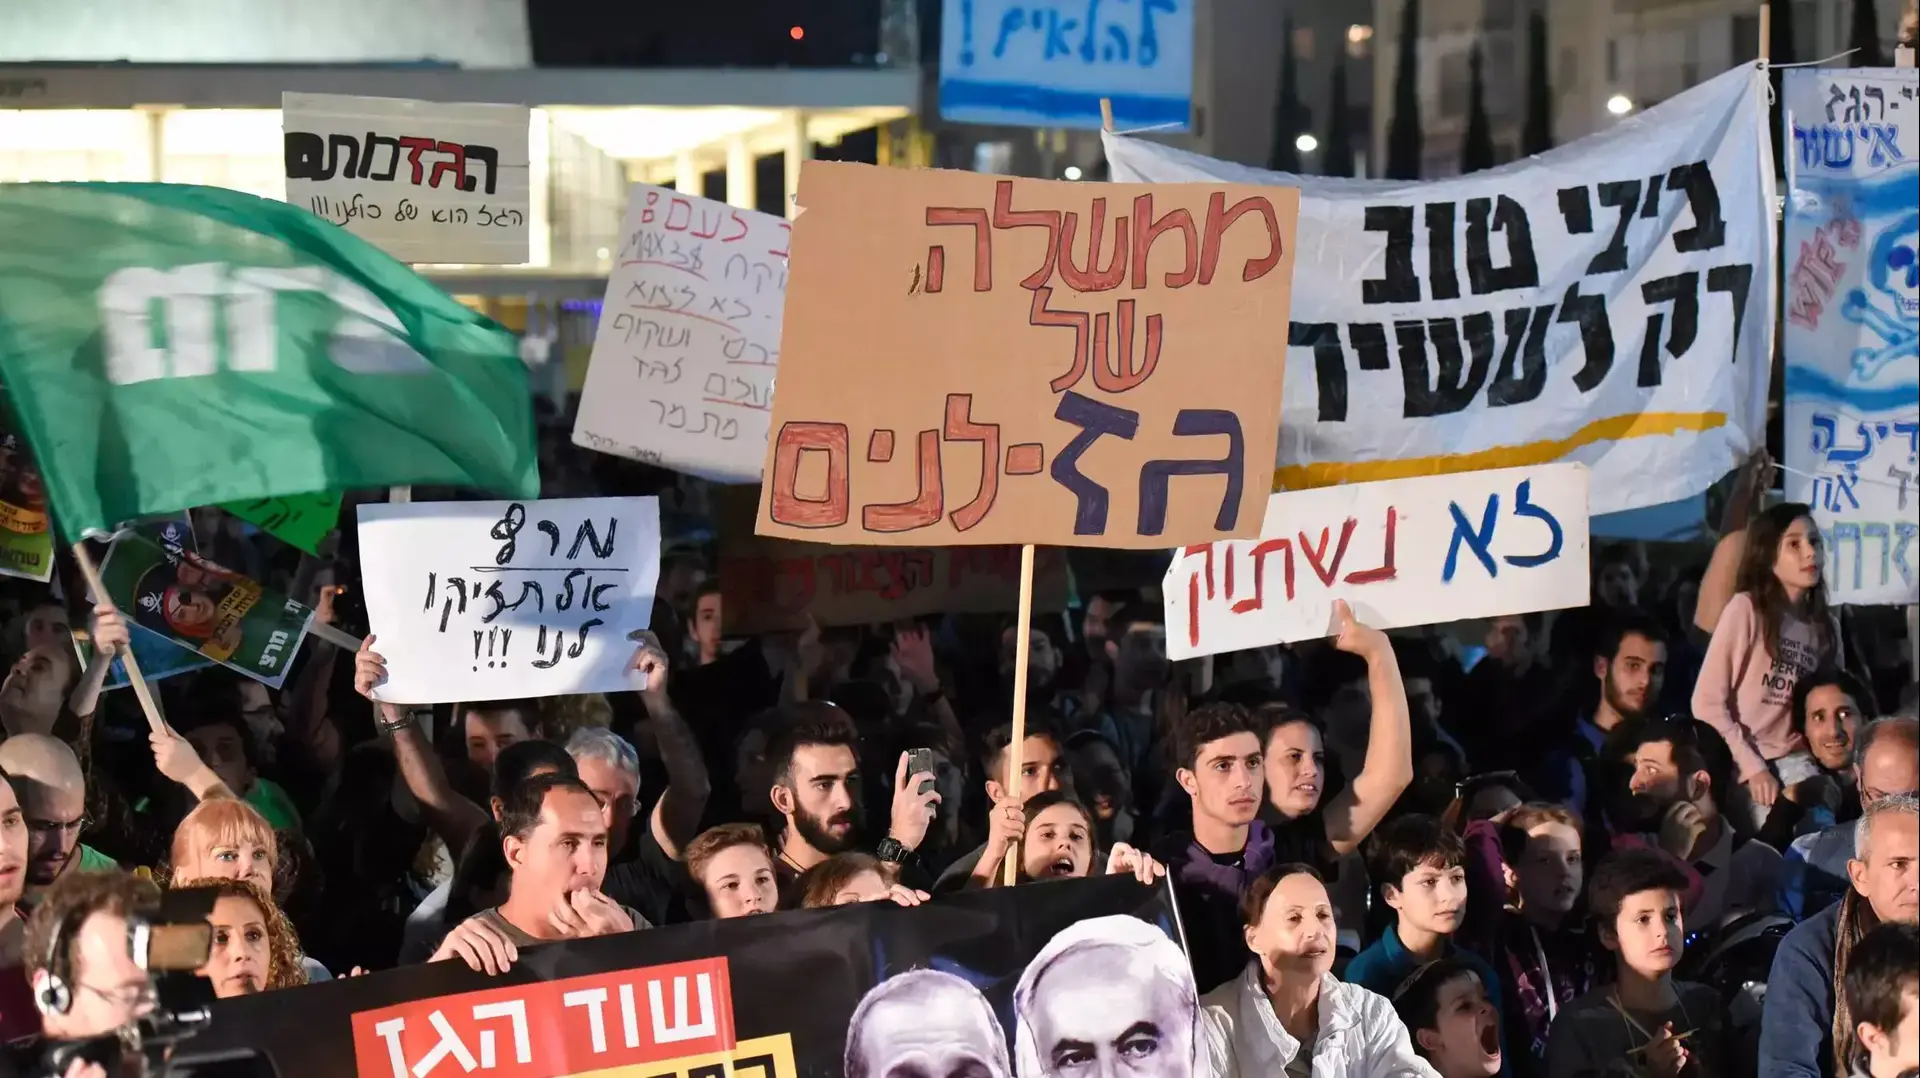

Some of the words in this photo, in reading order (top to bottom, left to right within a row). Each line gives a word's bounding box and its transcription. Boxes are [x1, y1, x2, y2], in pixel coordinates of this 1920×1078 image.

[284, 132, 498, 194] הגזמתם
[395, 199, 418, 221] של
[432, 208, 468, 225] הוא
[476, 205, 523, 226] הגז
[925, 181, 1283, 293] ממשלה
[1362, 194, 1538, 304] טוב
[1029, 287, 1163, 394] של
[1288, 281, 1615, 422] לעשיר
[1637, 264, 1753, 388] רק
[1183, 505, 1401, 648] נשתוק
[1441, 477, 1564, 584] לא
[375, 998, 533, 1078] הגז
[562, 971, 718, 1055] שוד
